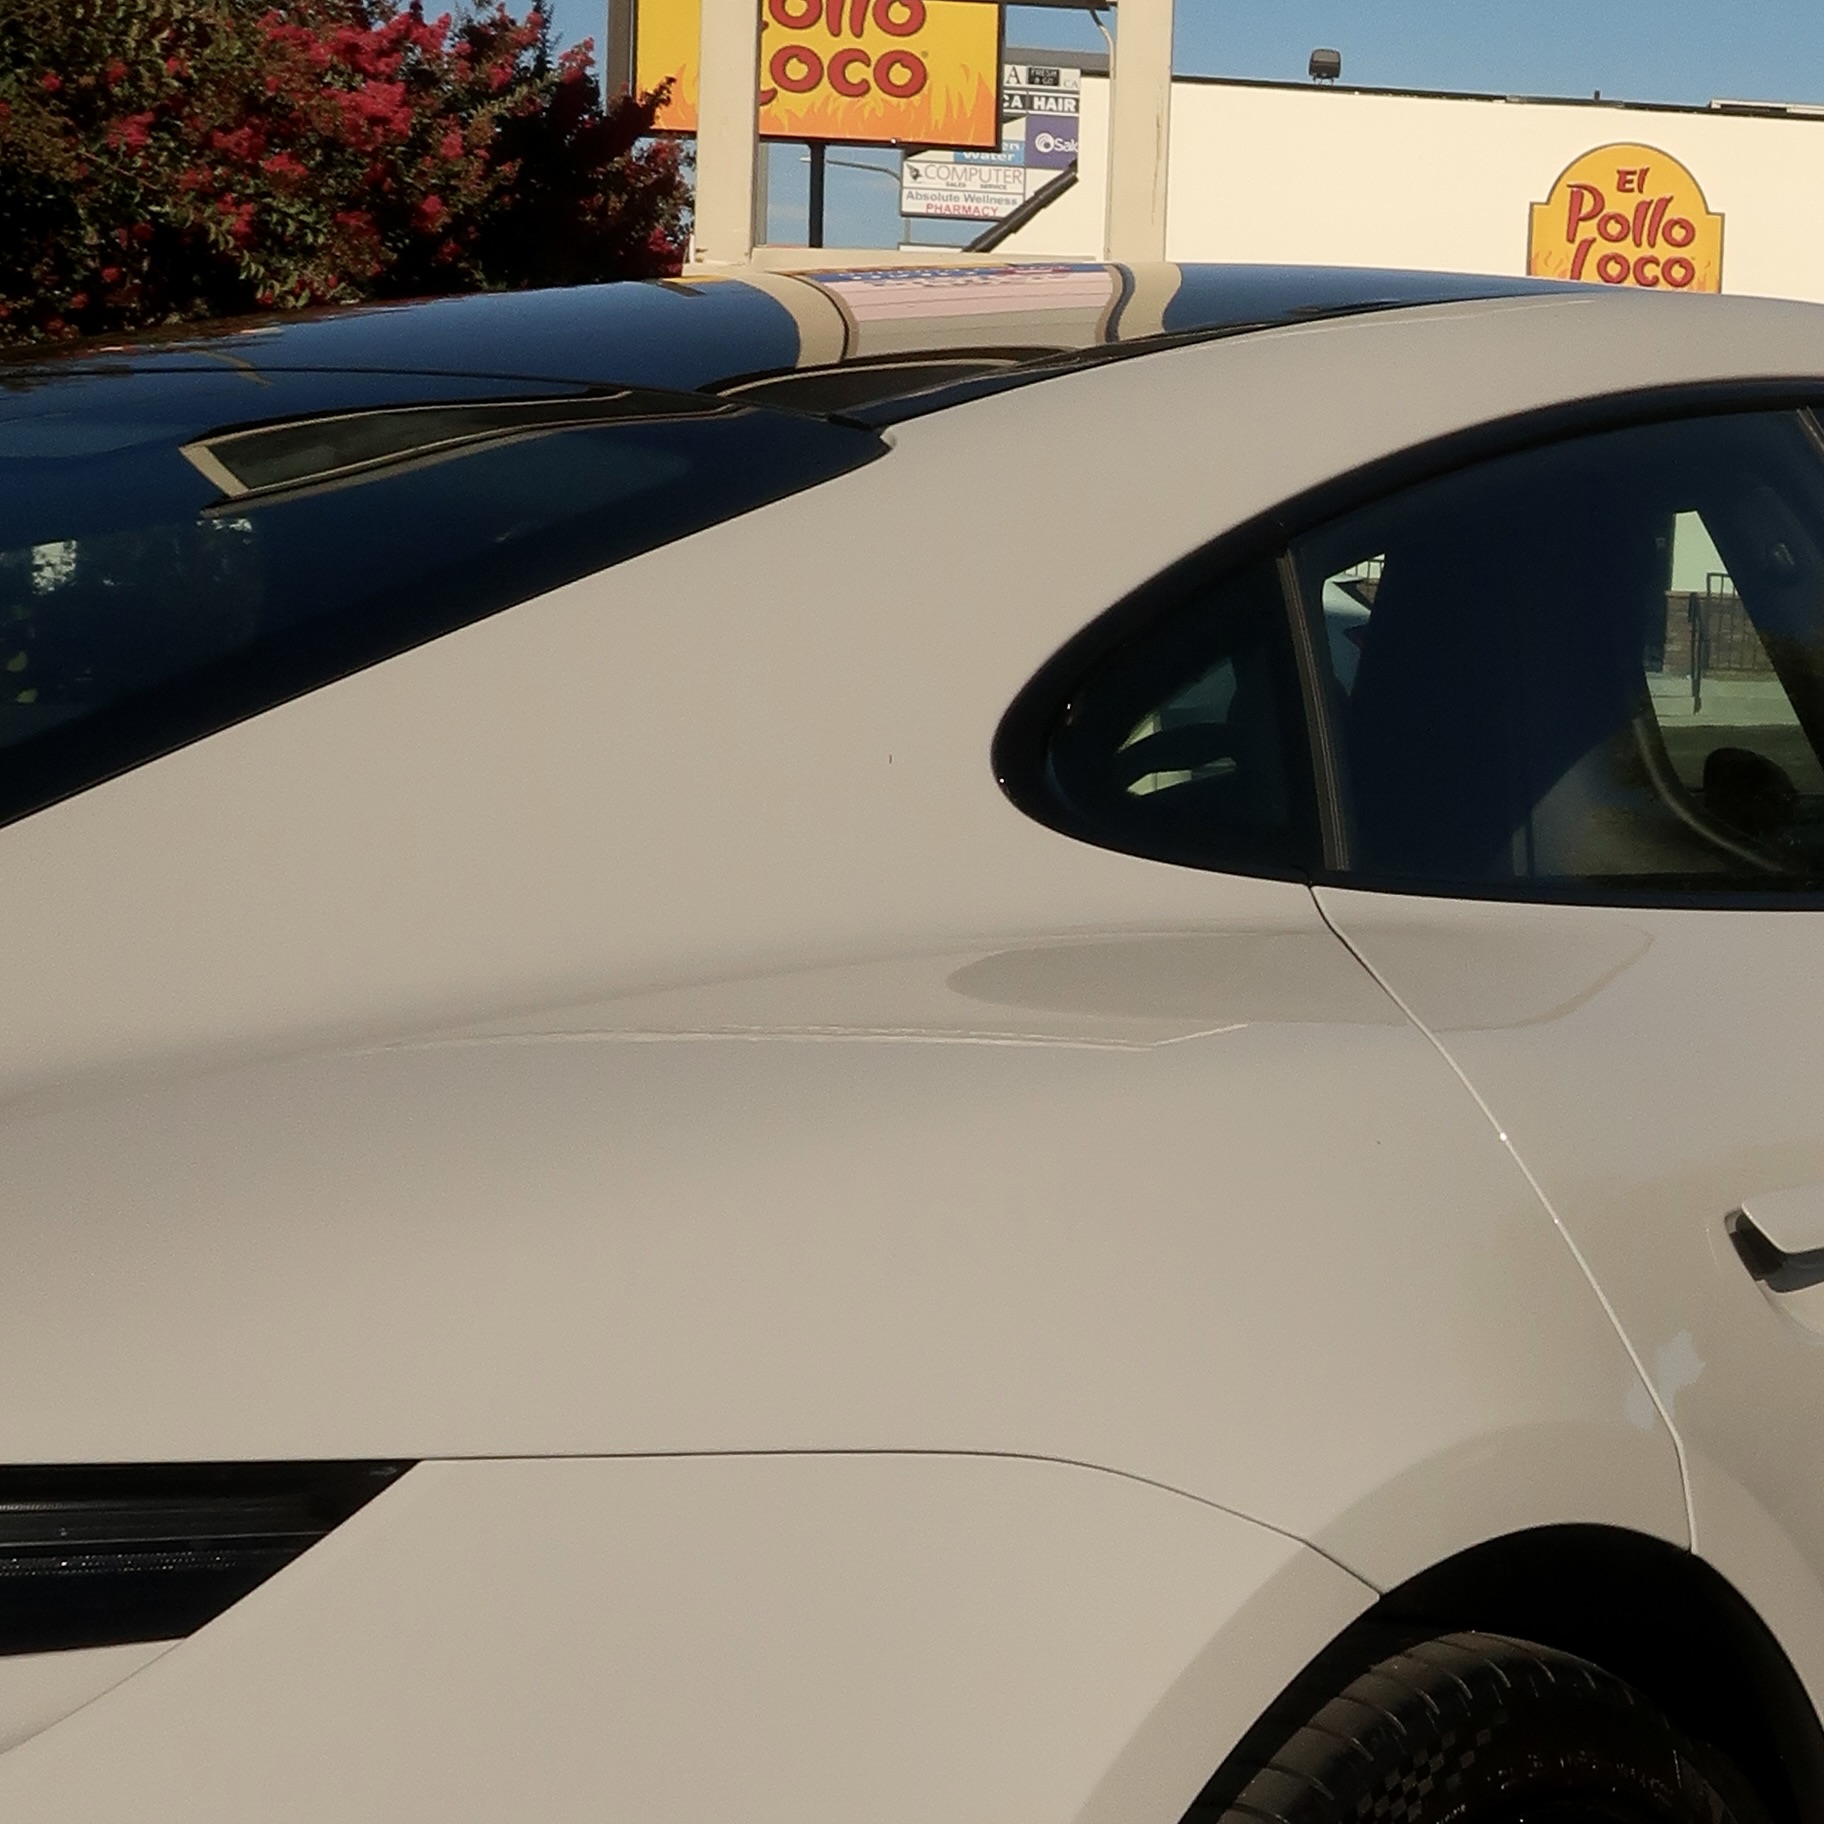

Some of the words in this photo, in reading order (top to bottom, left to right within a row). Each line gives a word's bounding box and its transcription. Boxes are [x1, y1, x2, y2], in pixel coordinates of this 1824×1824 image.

[760, 44, 928, 106] oco
[1033, 96, 1077, 112] HAIR
[924, 164, 1023, 184] COMPUTER
[1616, 167, 1650, 194] El
[906, 190, 960, 203] Absolute
[963, 192, 1018, 206] Wellness
[925, 202, 999, 217] PHARMACY
[1566, 183, 1696, 248] Pollo
